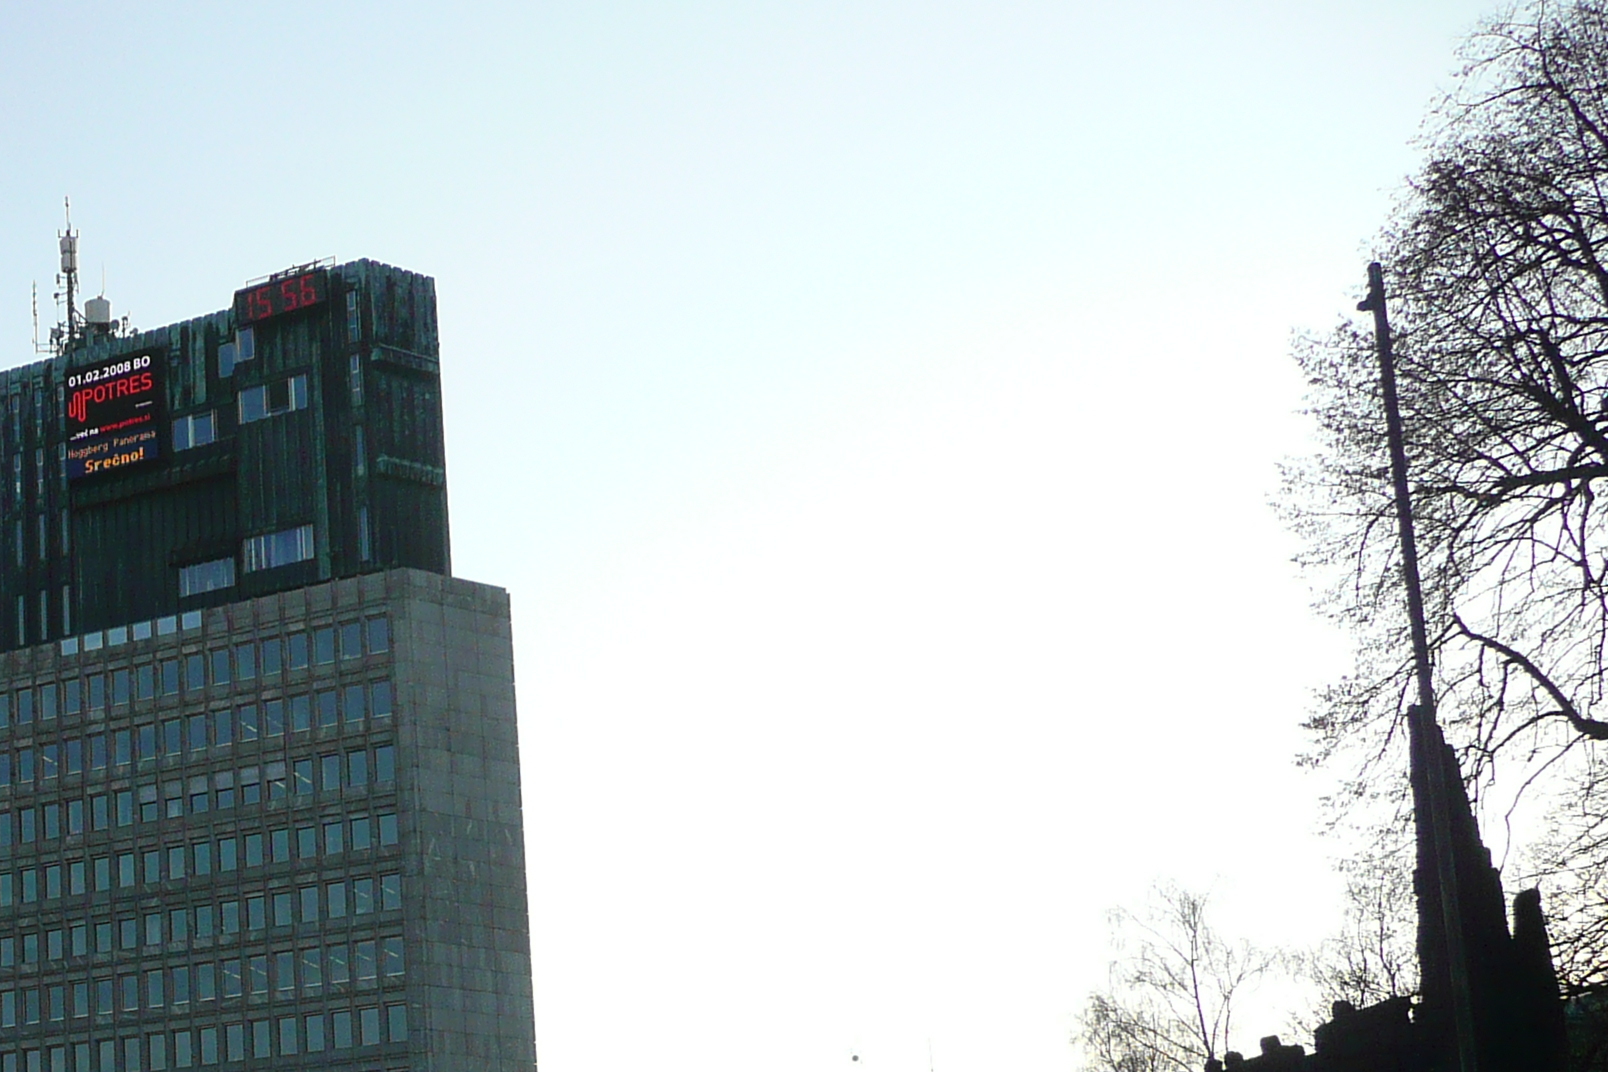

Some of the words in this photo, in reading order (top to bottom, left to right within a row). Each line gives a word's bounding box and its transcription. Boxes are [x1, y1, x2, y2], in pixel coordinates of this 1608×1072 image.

[246, 286, 273, 320] 15
[281, 273, 317, 311] 56
[68, 360, 131, 388] 01.02.2008
[133, 355, 151, 370] BO
[68, 372, 153, 423] POTRES
